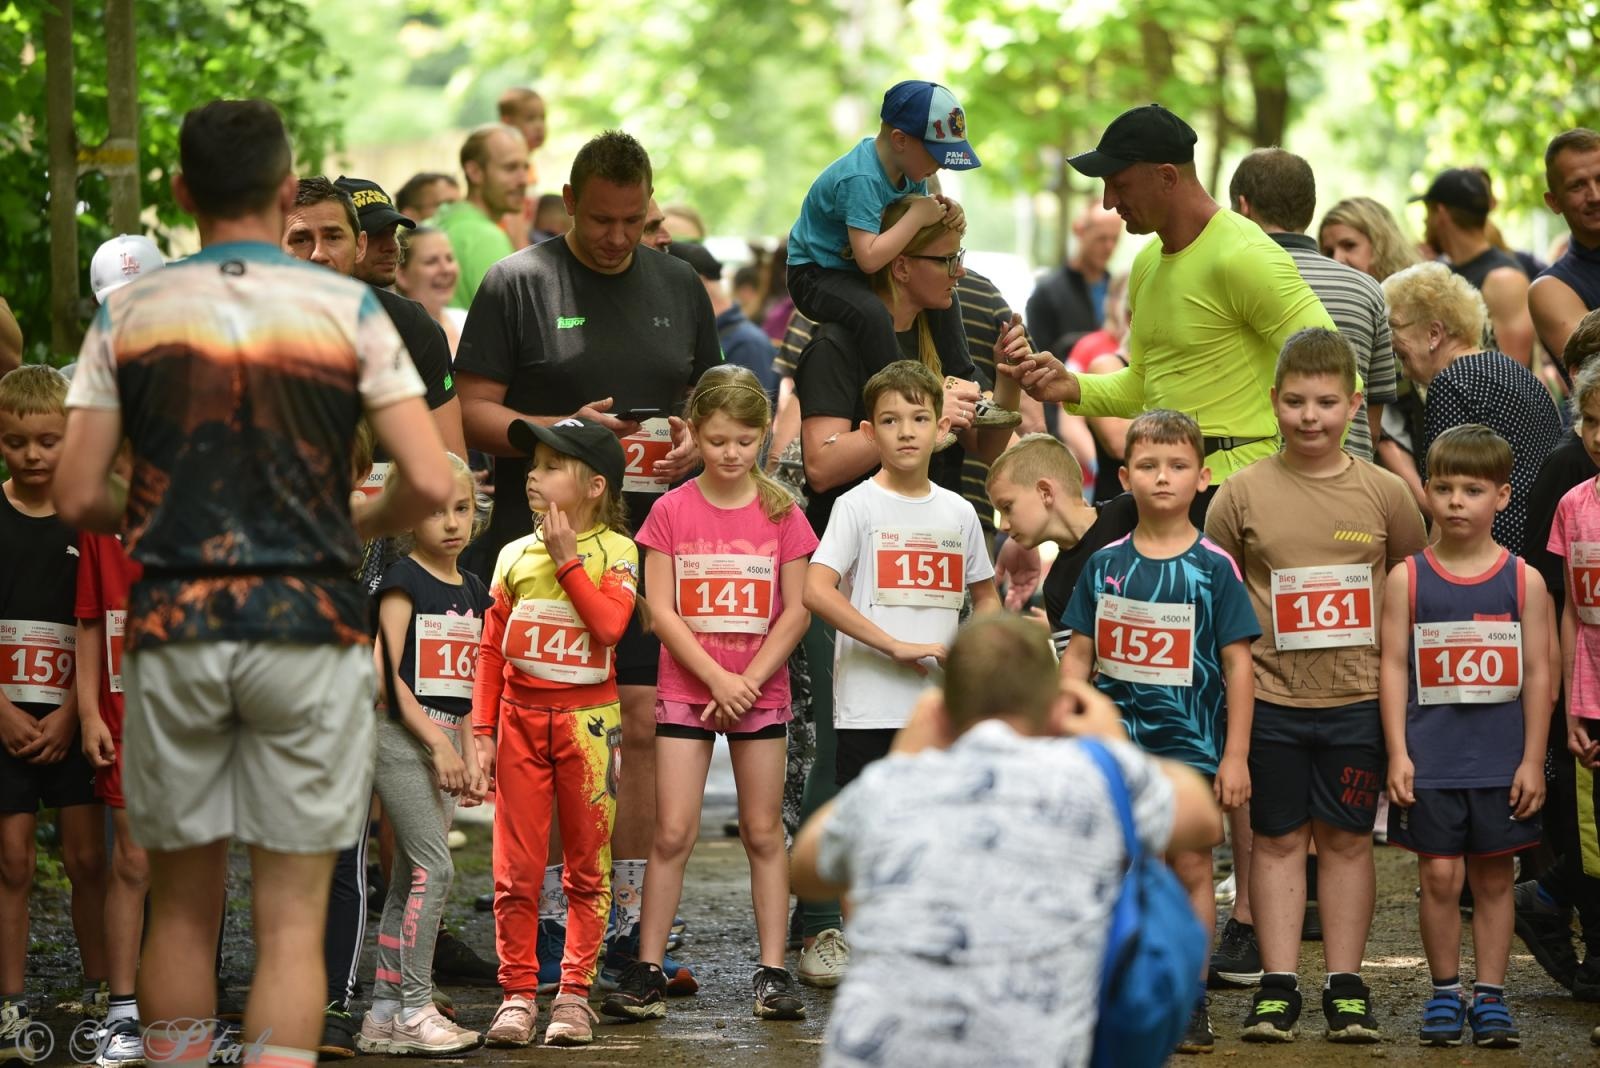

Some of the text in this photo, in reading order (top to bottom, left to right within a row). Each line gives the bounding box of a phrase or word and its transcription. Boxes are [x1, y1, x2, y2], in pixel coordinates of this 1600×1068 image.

[353, 190, 382, 198] STAR
[352, 196, 388, 207] WARS
[368, 473, 384, 481] 500
[881, 532, 899, 541] Bieg
[941, 539, 956, 548] 4500
[683, 560, 700, 569] Bieg
[746, 565, 763, 575] 4500
[764, 567, 771, 575] M
[894, 553, 953, 589] 151
[1278, 574, 1296, 584] Bieg
[1345, 575, 1361, 583] 4500
[695, 581, 759, 614] 141
[520, 602, 535, 613] Bieg
[1104, 599, 1119, 612] Bieg
[1292, 592, 1360, 629] 161
[1160, 615, 1190, 623] 4500 M
[0, 624, 17, 635] Bieg
[424, 620, 442, 630] Bieg
[1422, 628, 1440, 638] Bieg
[1488, 632, 1507, 641] 4500
[1508, 633, 1516, 641] M
[523, 625, 592, 665] 144
[1110, 625, 1175, 665] 152
[10, 648, 73, 685] 159
[1434, 649, 1504, 684] 160
